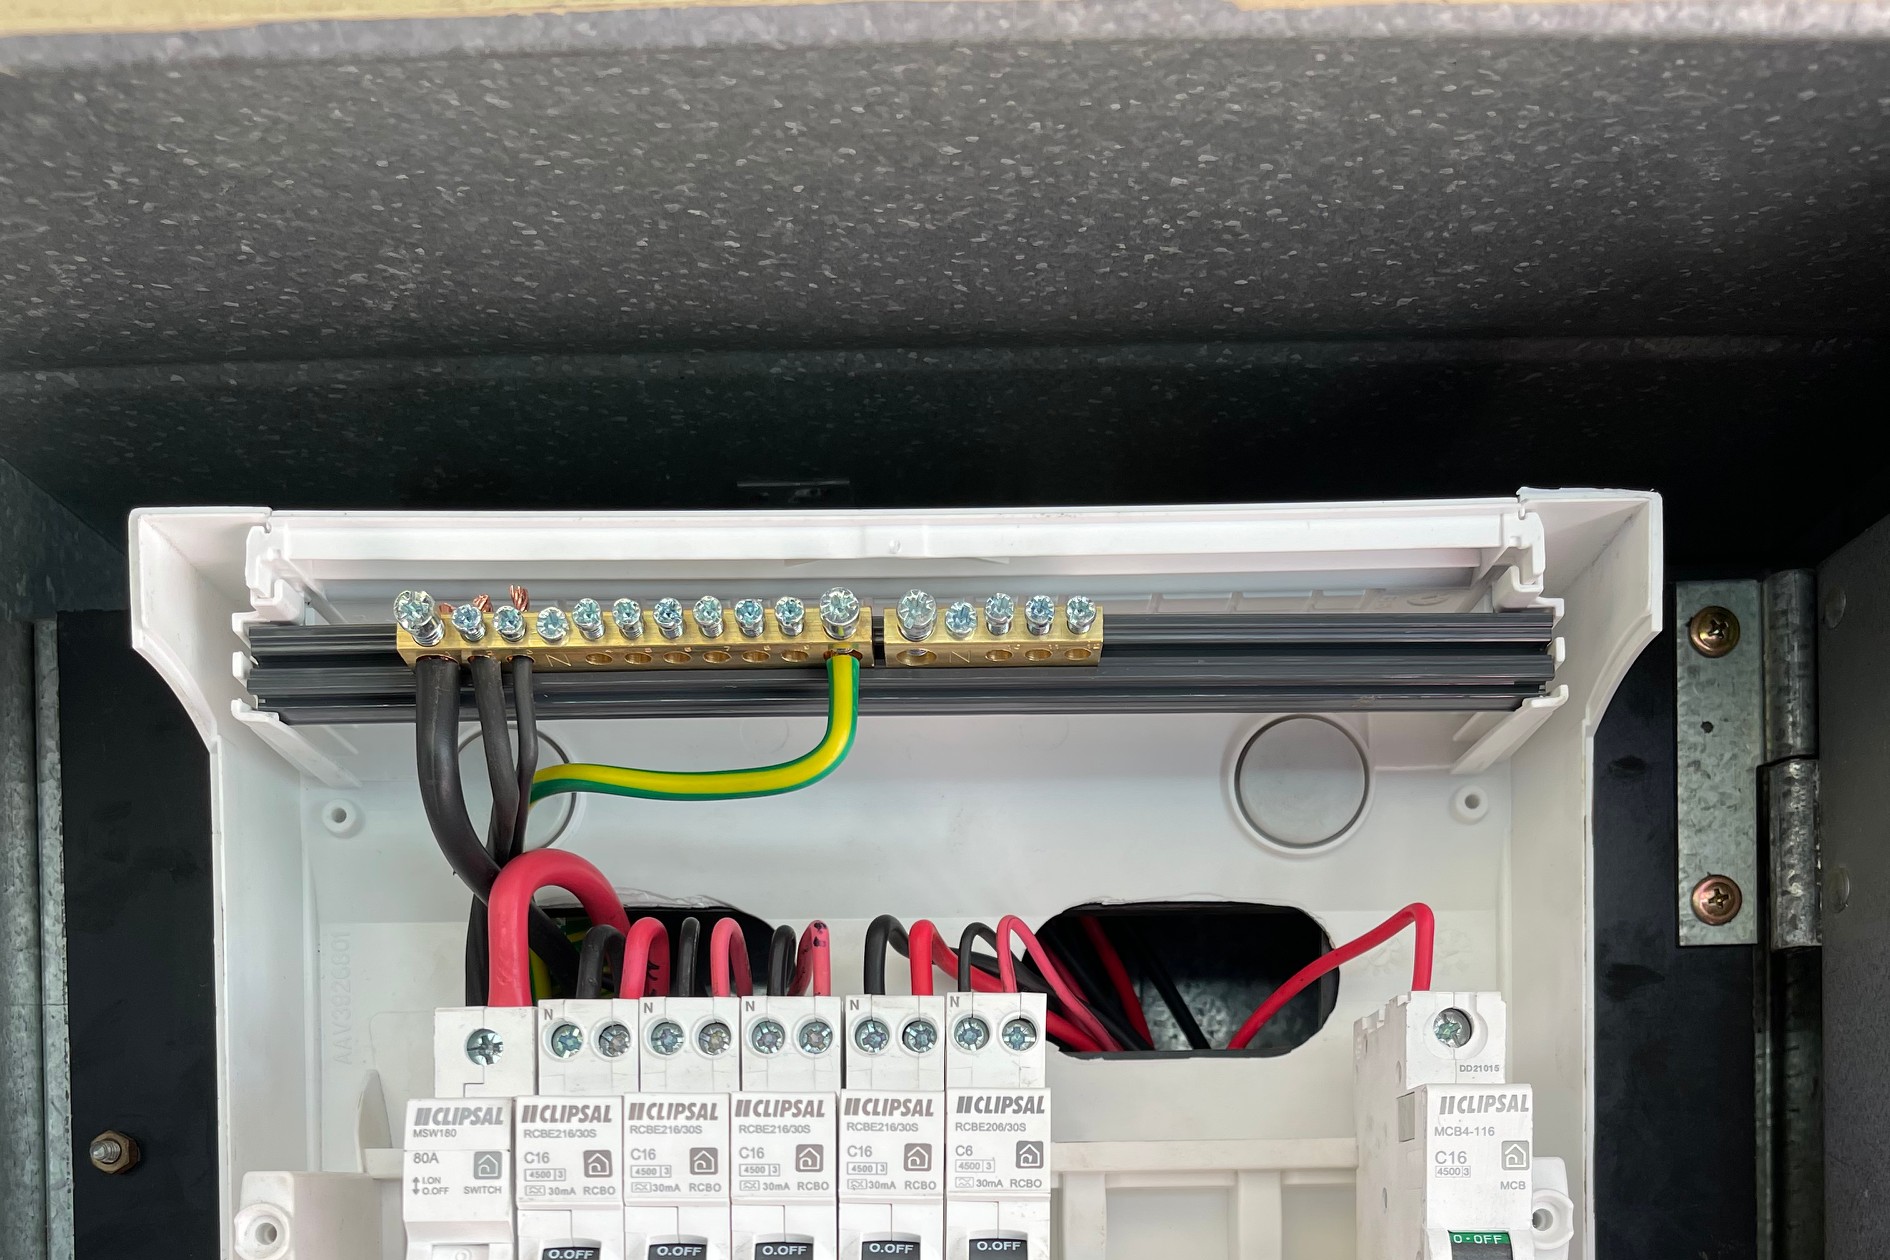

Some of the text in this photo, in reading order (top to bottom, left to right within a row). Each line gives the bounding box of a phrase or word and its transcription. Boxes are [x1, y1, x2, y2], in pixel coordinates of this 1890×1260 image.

[745, 1001, 755, 1012] N
[850, 999, 860, 1010] N
[950, 997, 960, 1008] N
[644, 1003, 653, 1013] N
[544, 1009, 554, 1020] N
[753, 1099, 825, 1117] CLIPSAL
[862, 1098, 934, 1117] CLIPSAL
[973, 1096, 1045, 1114] CLIPSAL
[1457, 1094, 1529, 1114] CLIPSAL
[432, 1107, 503, 1126] CLIPSAL
[540, 1105, 612, 1124] CLIPSAL
[646, 1103, 718, 1121] CLIPSAL
[630, 1125, 703, 1135] RCBE216/30S
[738, 1124, 811, 1134] RCBE216/30S
[847, 1122, 919, 1132] RCBE216/30S
[955, 1122, 1027, 1132] RCBE206/30S
[1434, 1126, 1495, 1136] MCB4-116
[413, 1129, 457, 1138] MSW180
[523, 1129, 597, 1139] RCBE216/30S
[630, 1149, 656, 1161] C16
[739, 1147, 765, 1159] C16
[847, 1145, 873, 1158] C16
[955, 1145, 973, 1157] C6
[413, 1152, 439, 1164] 80A
[524, 1152, 550, 1164] C16
[1435, 1151, 1467, 1164] C16
[743, 1166, 778, 1174] 4500 3
[851, 1164, 886, 1173] 4500 3
[958, 1162, 992, 1170] 4500 3
[529, 1170, 564, 1179] 4500 3
[635, 1167, 670, 1176] 4500 3
[652, 1182, 722, 1192] 30mA RCBO
[762, 1181, 829, 1191] 30mA RCBO
[868, 1180, 937, 1191] 30mA RCBO
[975, 1179, 1042, 1188] 30mA RCBO
[1500, 1181, 1526, 1190] MCB
[464, 1186, 502, 1195] SWITCH
[548, 1186, 616, 1196] 30mA RCBO
